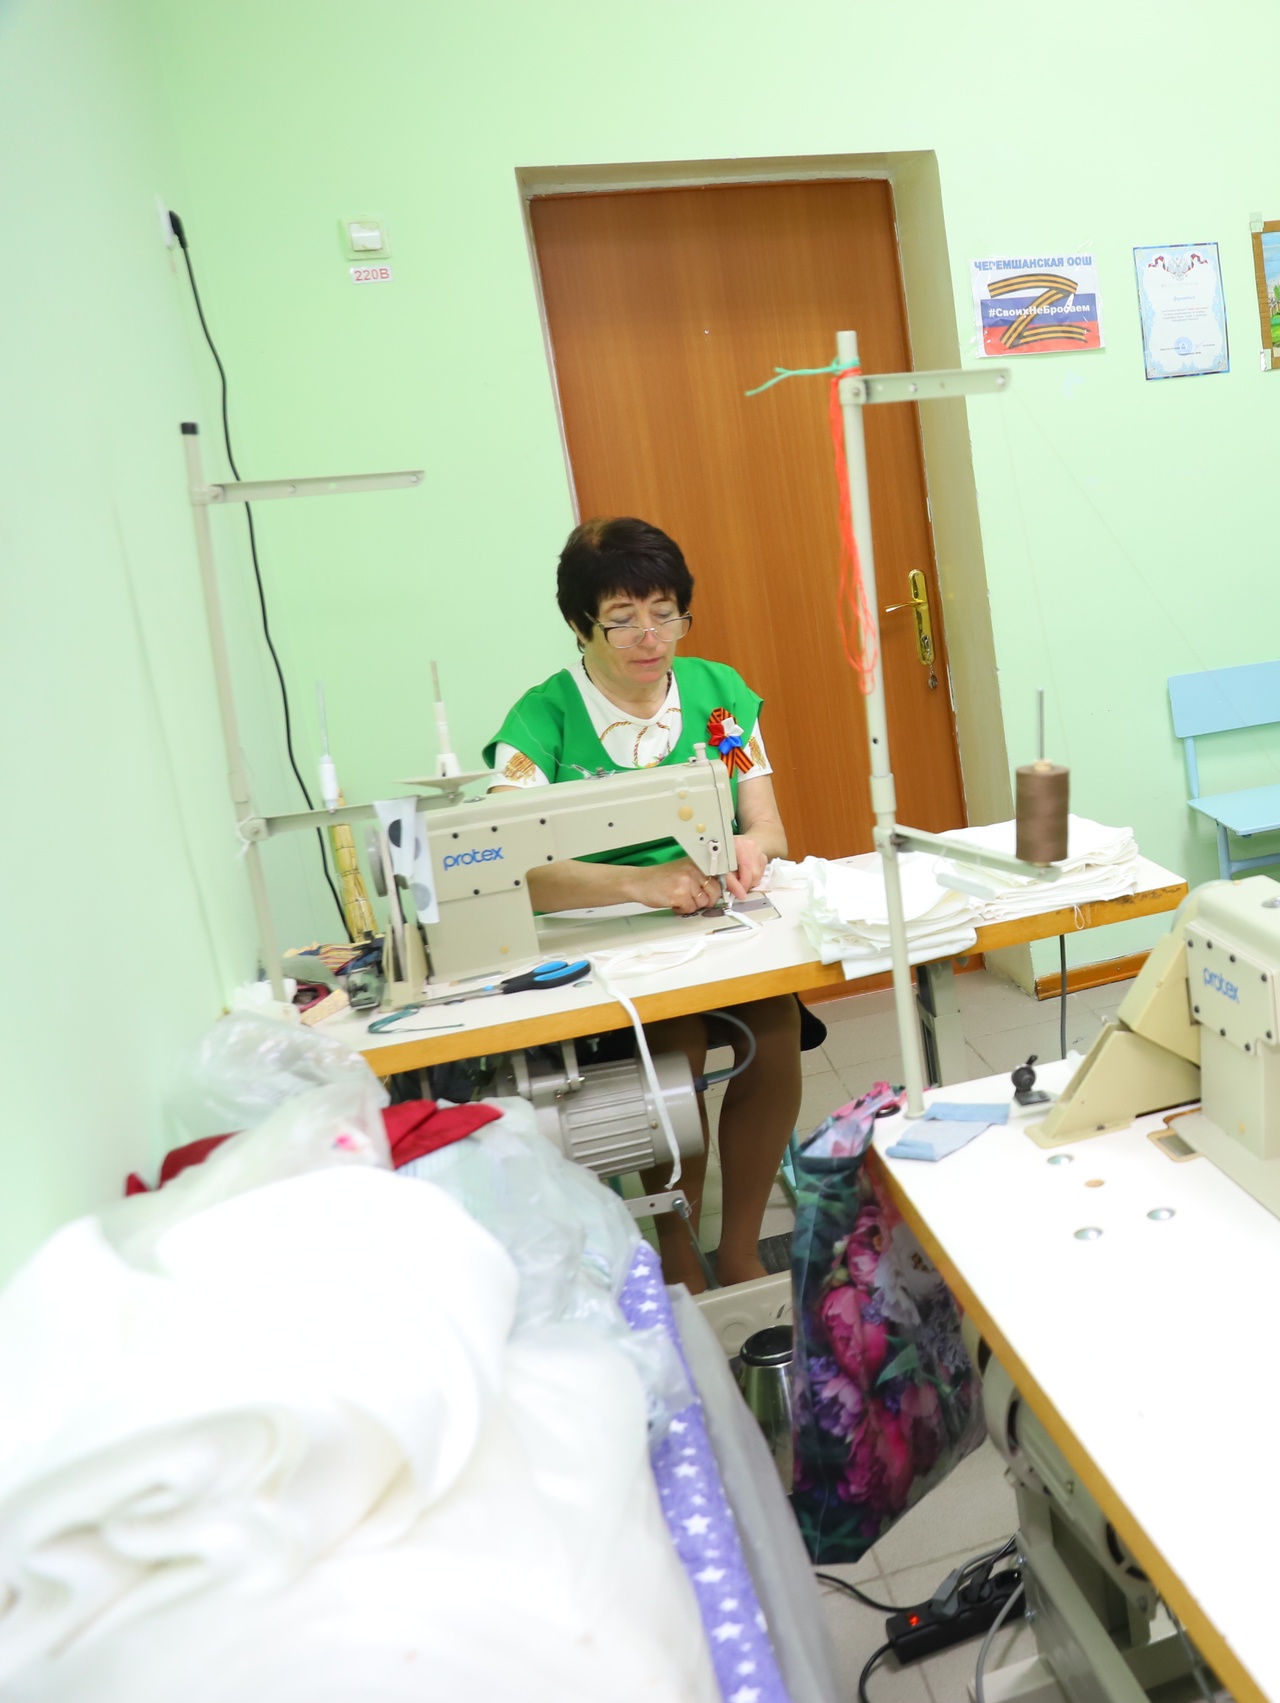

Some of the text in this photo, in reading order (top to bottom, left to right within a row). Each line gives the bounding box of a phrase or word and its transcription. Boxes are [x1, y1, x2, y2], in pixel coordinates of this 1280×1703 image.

[974, 256, 1093, 271] ЧЕРЕМШАНСКАЯ ООШ
[354, 268, 390, 281] 220В
[443, 847, 504, 871] protex
[1203, 967, 1240, 1005] protex
